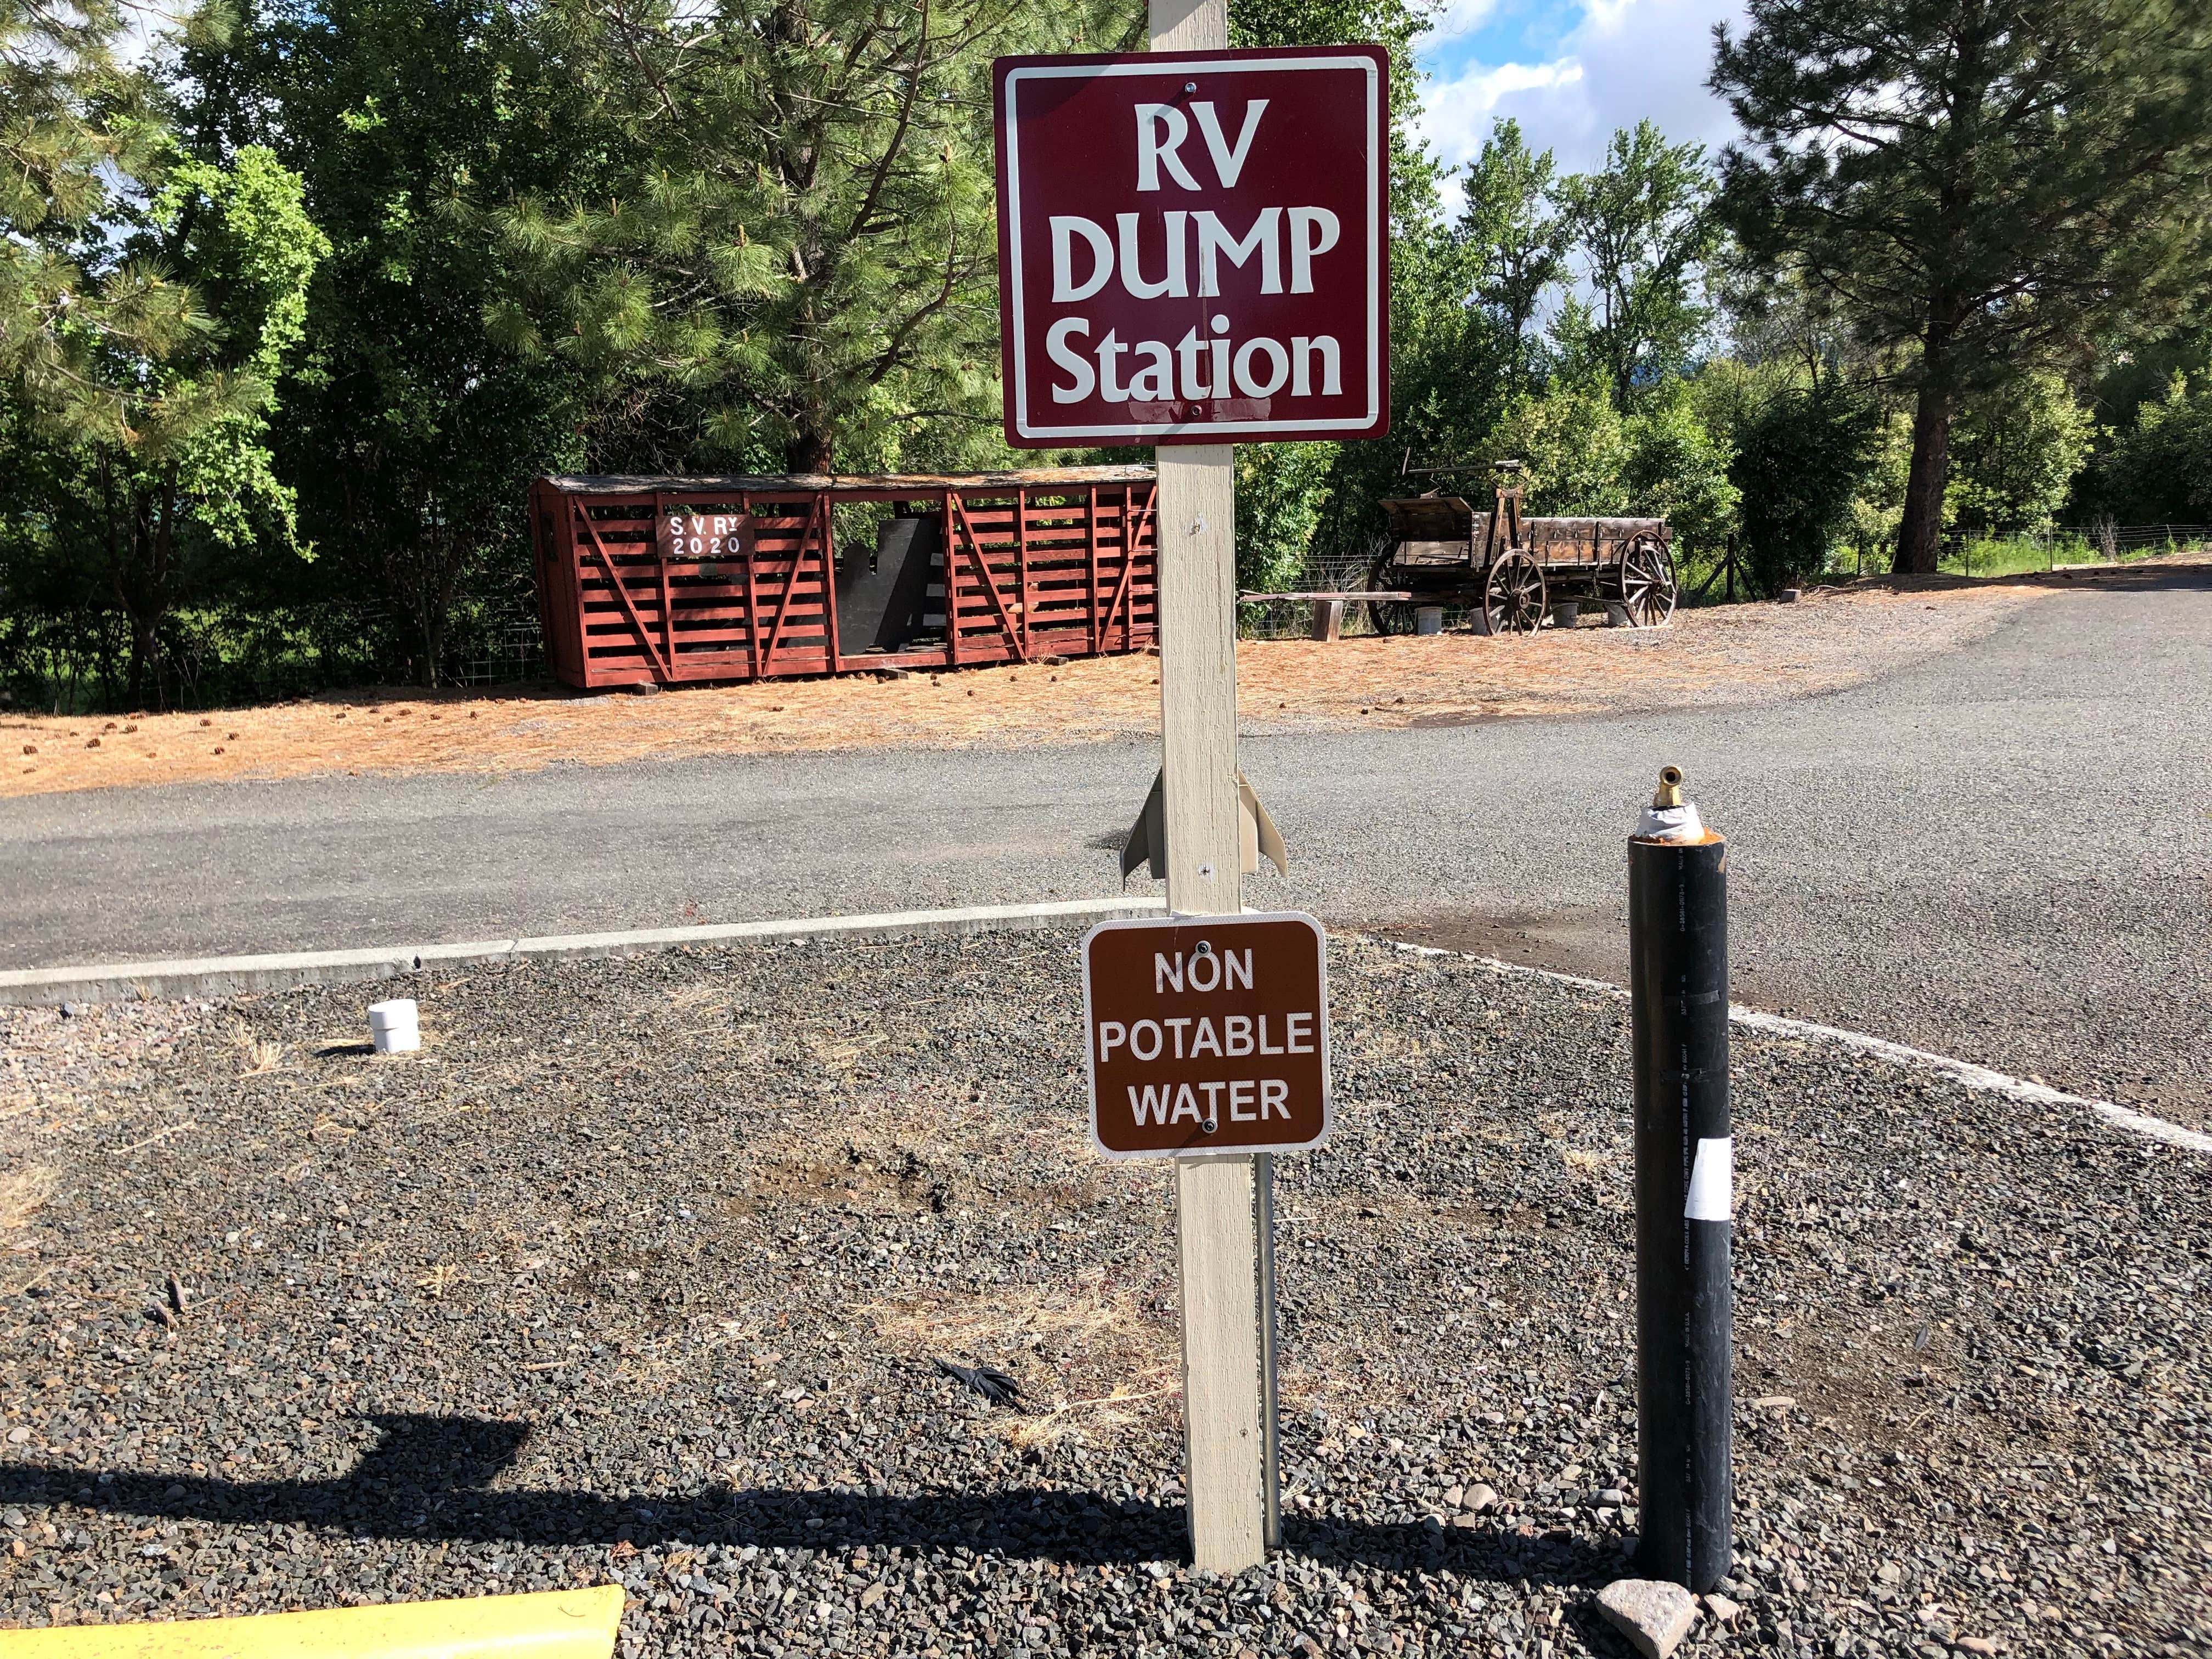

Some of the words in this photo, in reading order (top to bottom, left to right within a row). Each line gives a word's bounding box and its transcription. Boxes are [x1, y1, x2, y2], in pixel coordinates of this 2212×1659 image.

[1134, 99, 1270, 191] RV
[1049, 206, 1340, 303] DUMP
[1046, 314, 1342, 404] Station
[673, 537, 740, 555] 2020
[1154, 948, 1254, 994] NON
[1099, 1012, 1314, 1063] POTABLE
[1127, 1079, 1292, 1126] WATER
